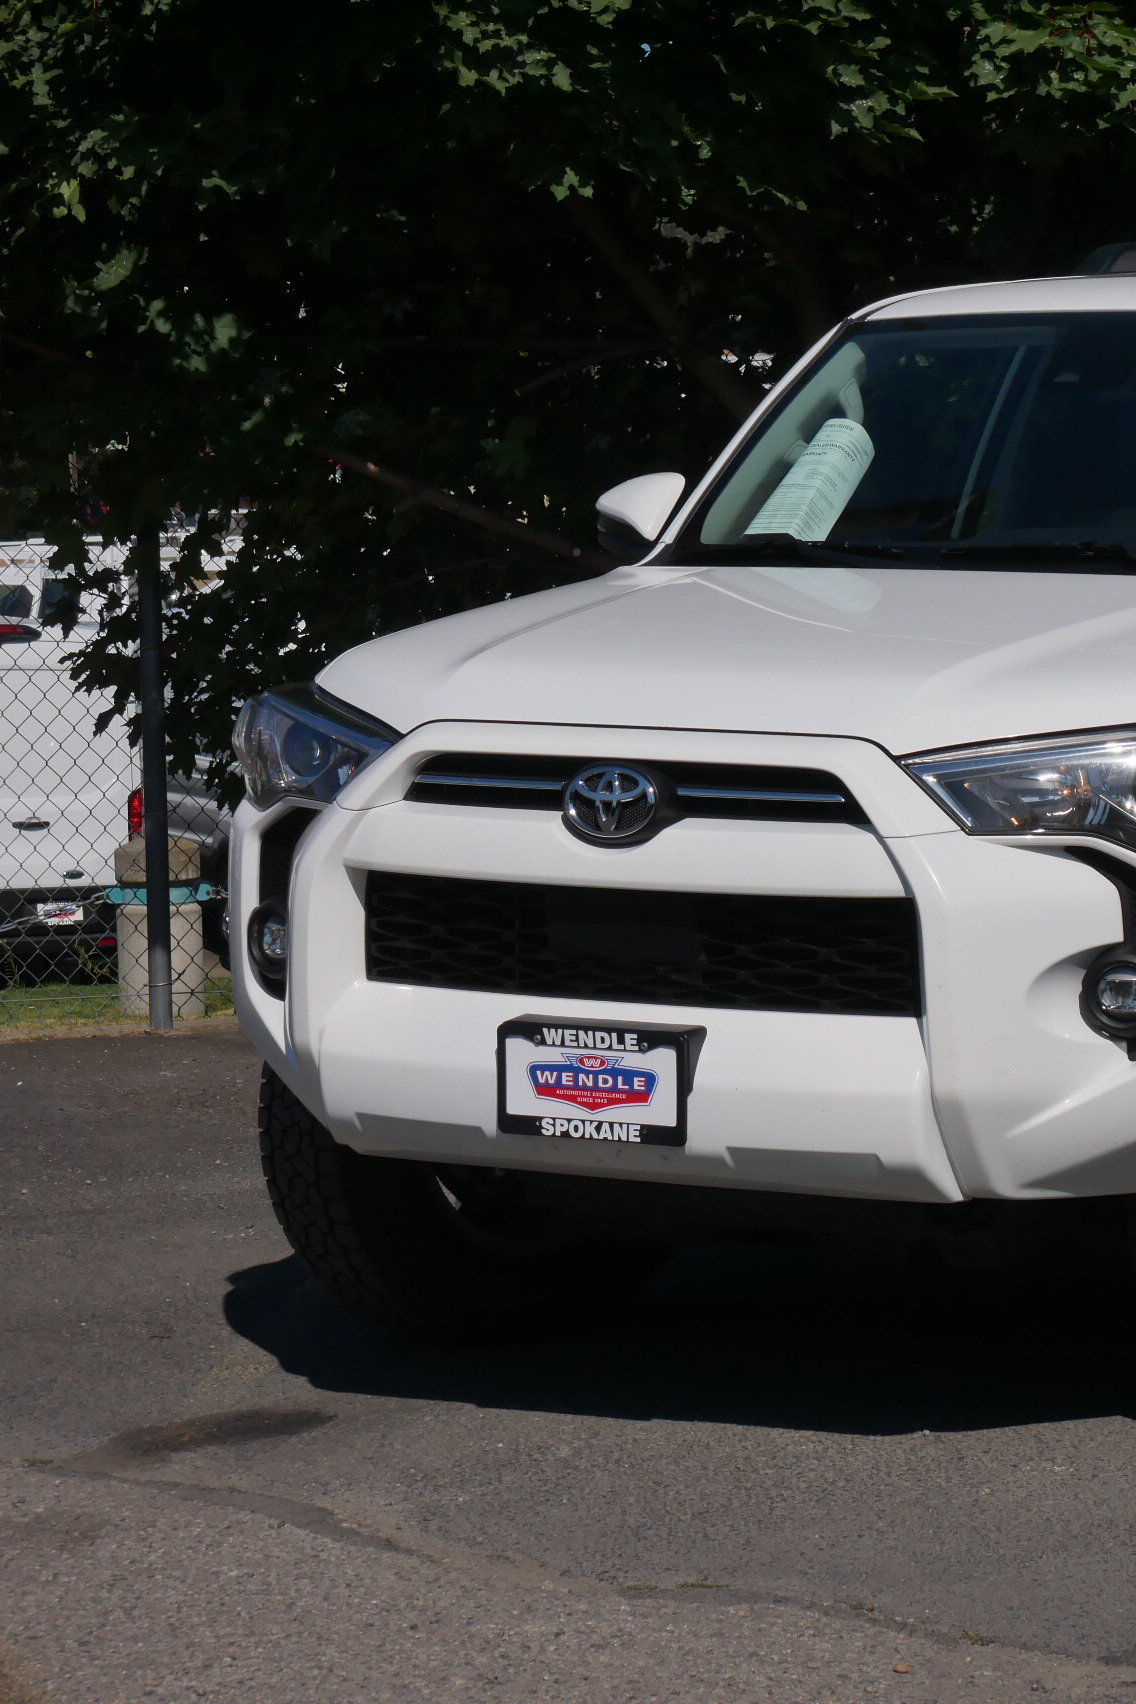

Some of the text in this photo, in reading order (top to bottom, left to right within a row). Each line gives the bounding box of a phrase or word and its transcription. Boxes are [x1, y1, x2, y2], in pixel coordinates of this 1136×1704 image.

[542, 1027, 639, 1051] WENDLE
[536, 1070, 647, 1091] WENDLE
[556, 1089, 591, 1097] AUTOMOTIVE
[541, 1117, 641, 1143] SPOKANE
